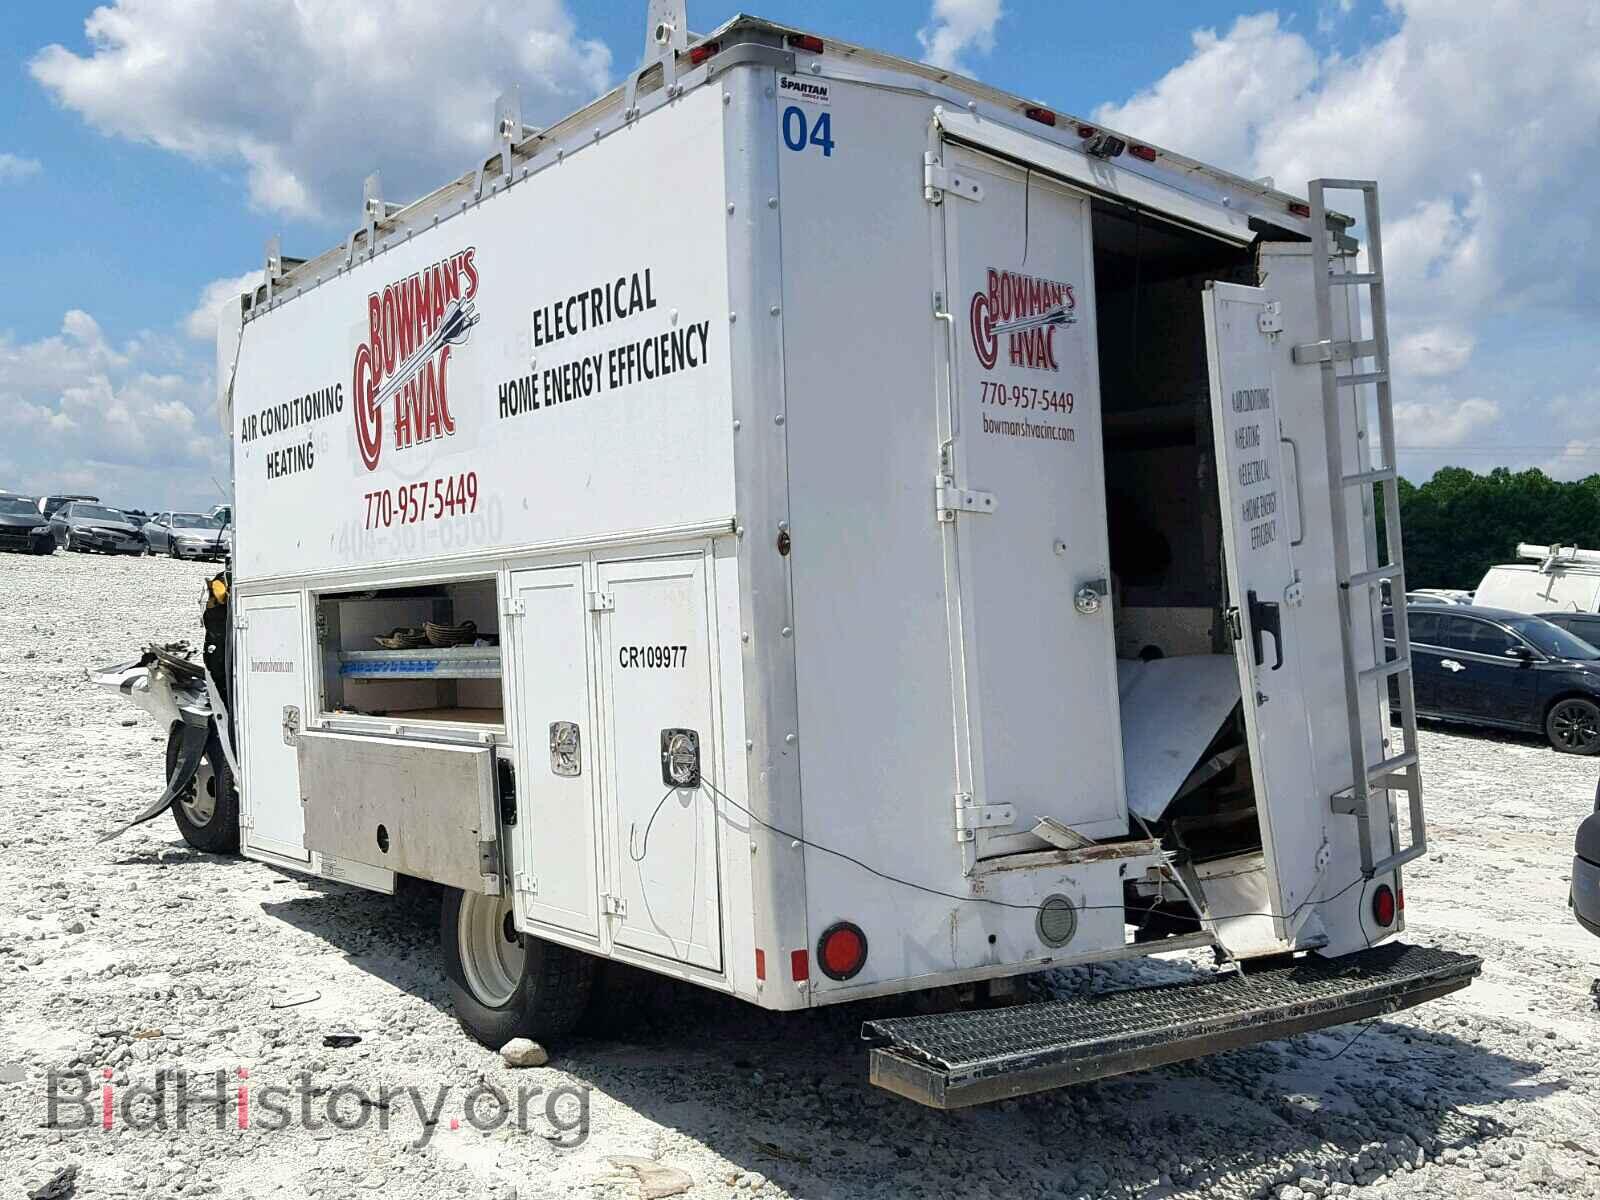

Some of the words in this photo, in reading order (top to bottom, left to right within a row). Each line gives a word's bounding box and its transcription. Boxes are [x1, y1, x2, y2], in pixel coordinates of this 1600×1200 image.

[780, 77, 828, 96] SPARTAN
[782, 106, 835, 157] 04
[368, 246, 479, 389] BOWMAN'S
[533, 267, 657, 348] ELECTRICAL
[987, 266, 1076, 323] BOWMAN'S
[498, 373, 540, 419] HOME
[543, 352, 602, 407] ENERGY
[608, 320, 710, 389] EFFICIENCY
[1010, 324, 1059, 372] HVAC
[241, 411, 258, 444] AIR
[260, 382, 344, 438] CONDITIONING
[394, 345, 456, 450] HVAC
[980, 381, 1074, 414] 770-957-5449
[982, 412, 1075, 443] bowmanshvacinc.com
[266, 441, 314, 480] HEATING
[364, 471, 478, 530] 770-957-5449
[619, 645, 688, 669] CR109977
